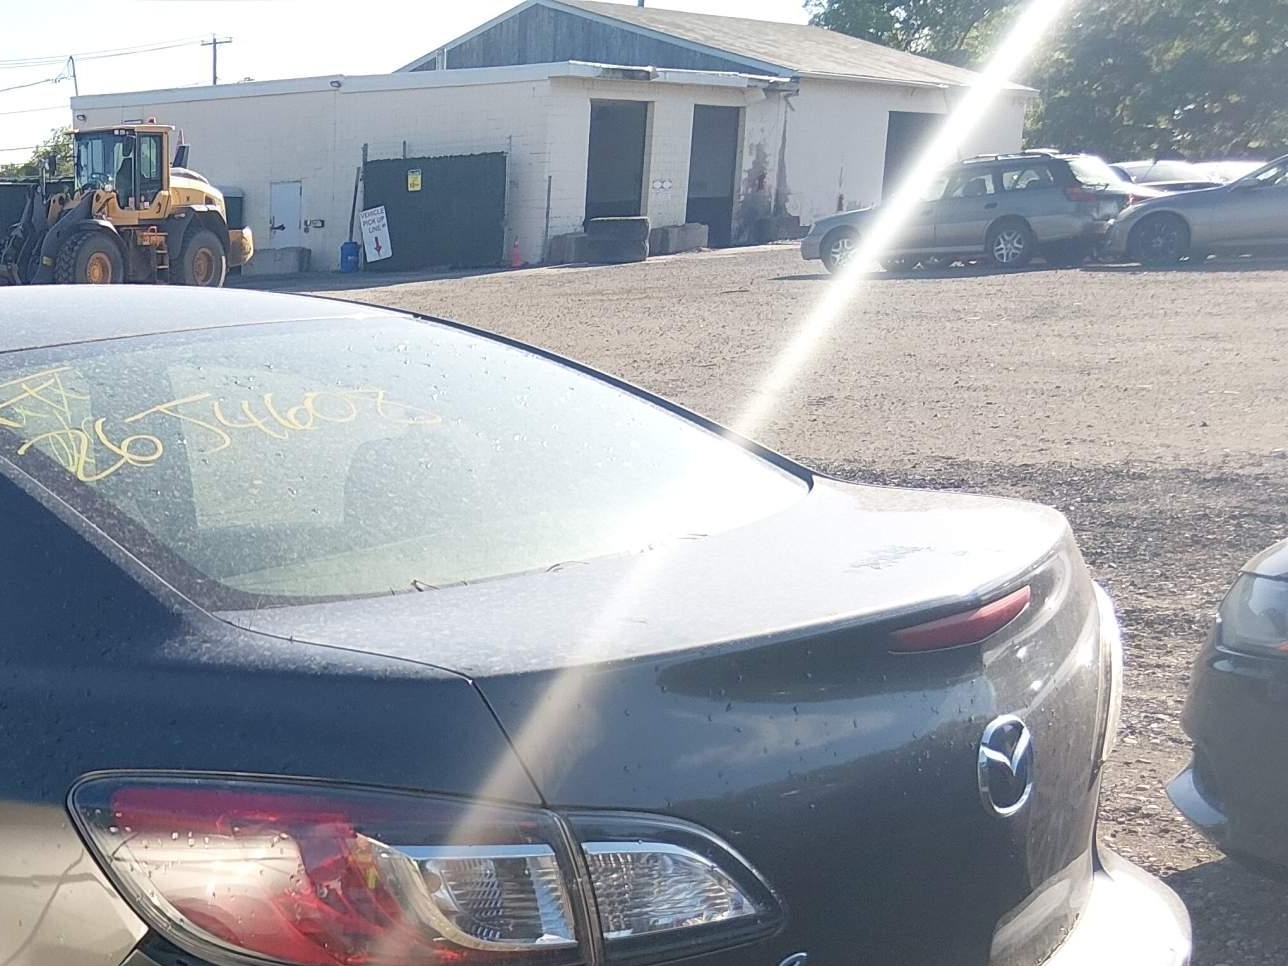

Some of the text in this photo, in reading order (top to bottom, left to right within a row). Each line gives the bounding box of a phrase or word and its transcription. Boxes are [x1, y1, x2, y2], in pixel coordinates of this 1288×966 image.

[360, 208, 385, 218] VEHICLE
[362, 215, 385, 227] PICK UP
[368, 225, 382, 234] LINE
